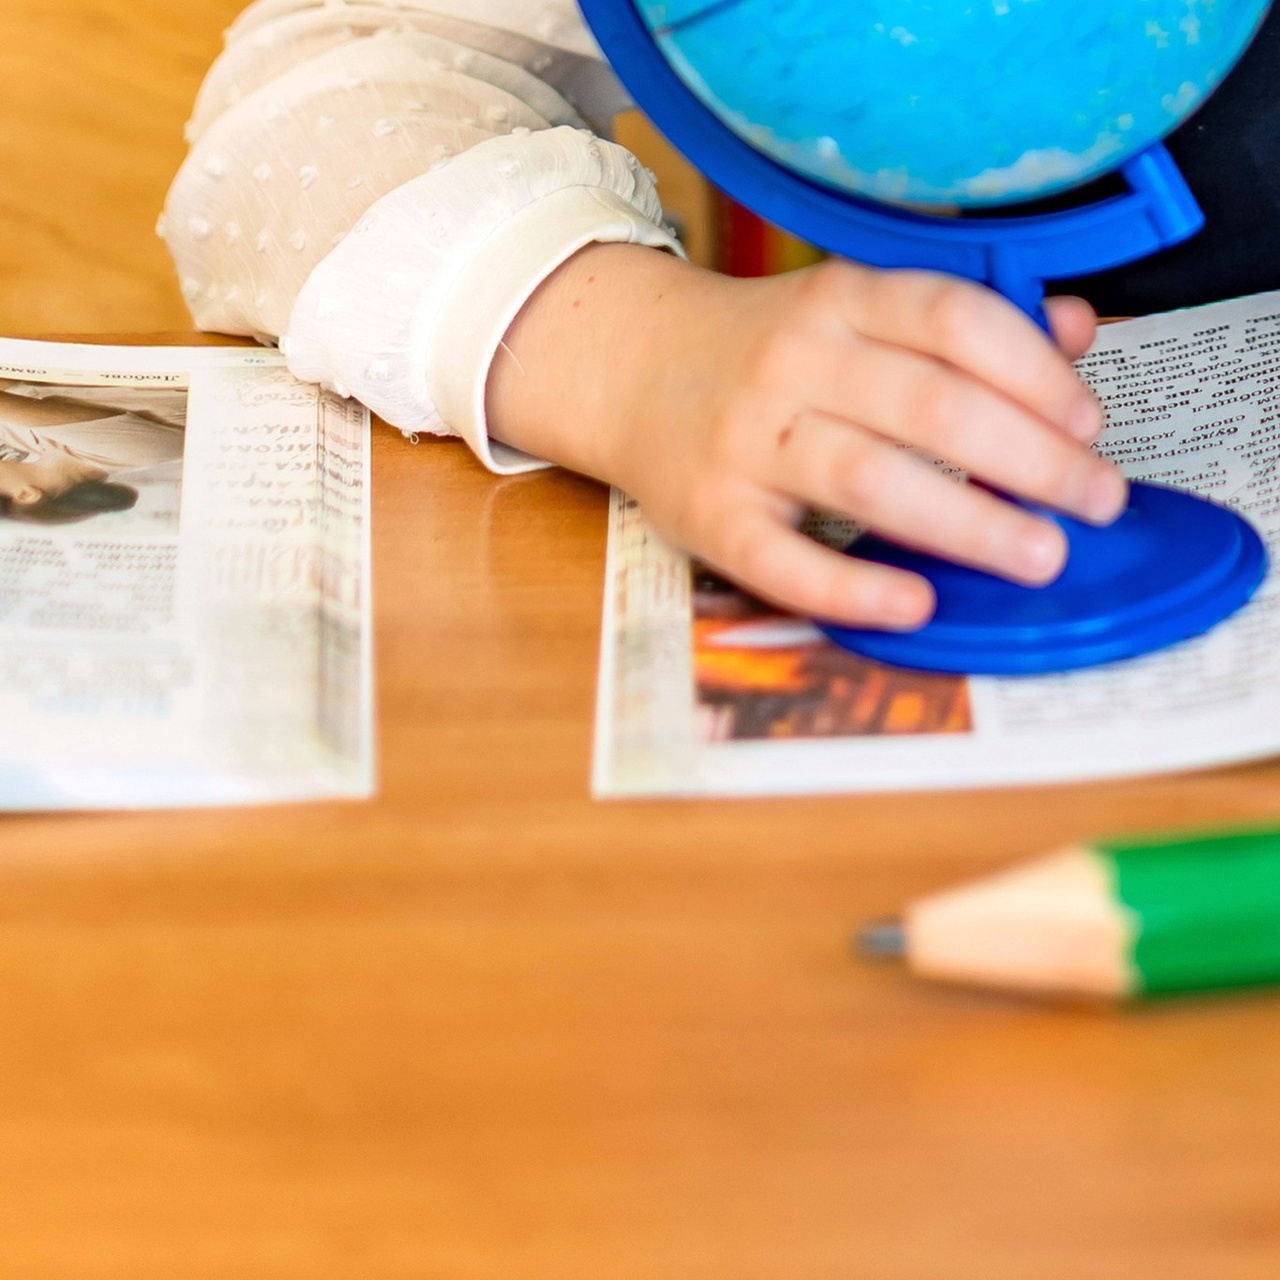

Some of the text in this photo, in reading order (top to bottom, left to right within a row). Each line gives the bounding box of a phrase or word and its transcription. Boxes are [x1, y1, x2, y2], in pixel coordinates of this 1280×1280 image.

[1193, 324, 1231, 339] ибо
[1139, 337, 1178, 350] они
[1158, 335, 1227, 355] такие:
[1117, 343, 1228, 372] проповеди
[100, 374, 180, 382] Любовь
[1116, 358, 1243, 390] содержится
[1164, 387, 1203, 400] так
[1211, 388, 1236, 399] во
[1133, 399, 1190, 413] всём,
[1192, 414, 1246, 433] свою
[1088, 430, 1176, 449] доброту
[1178, 426, 1238, 445] будет
[1113, 440, 1224, 465] говорится
[1252, 466, 1276, 477] не
